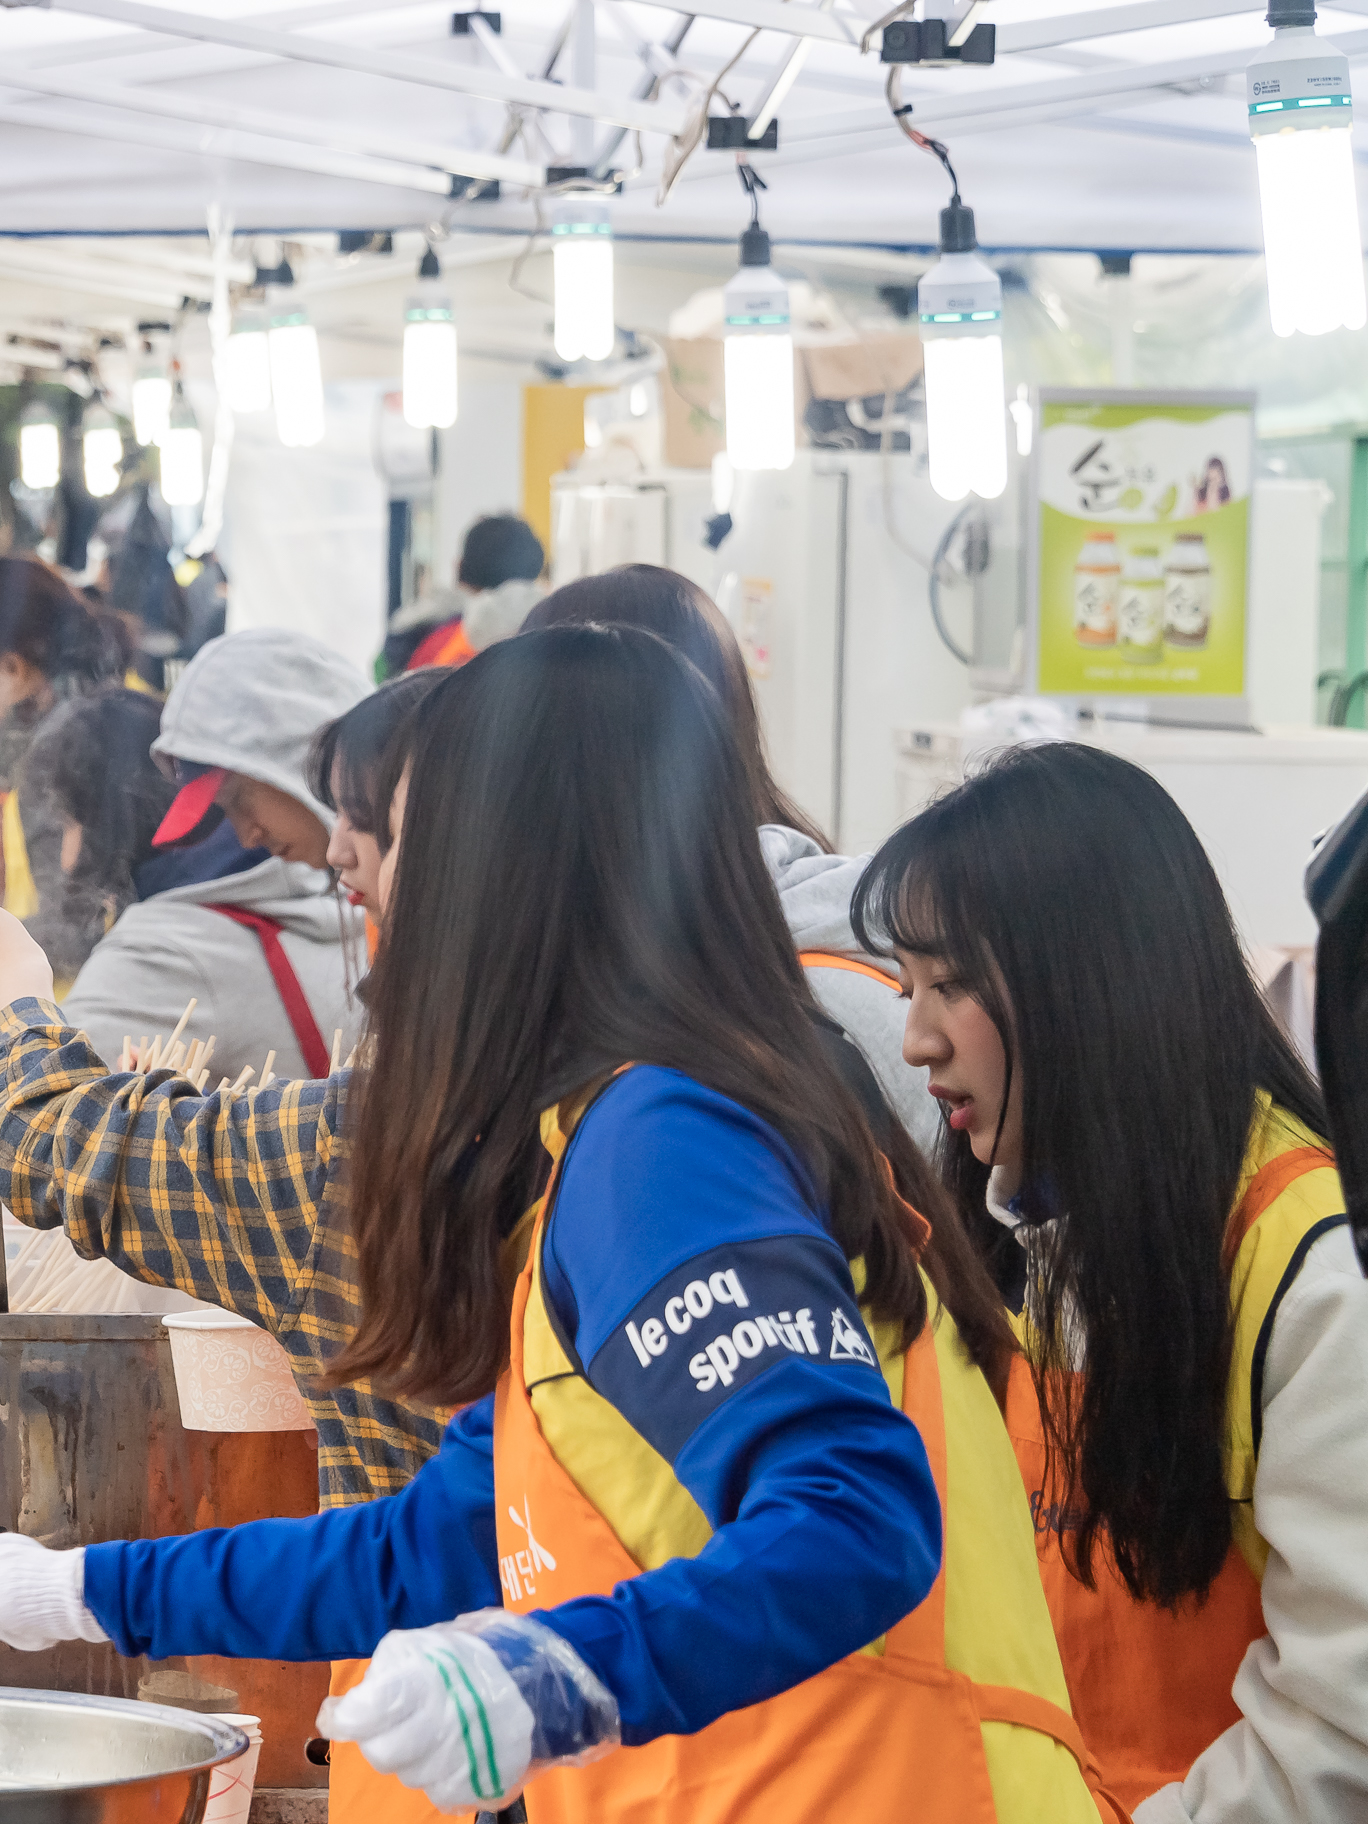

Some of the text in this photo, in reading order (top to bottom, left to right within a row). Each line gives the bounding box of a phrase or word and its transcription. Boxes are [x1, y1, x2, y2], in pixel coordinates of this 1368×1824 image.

[624, 1268, 750, 1368] le coq
[688, 1308, 821, 1393] sportif
